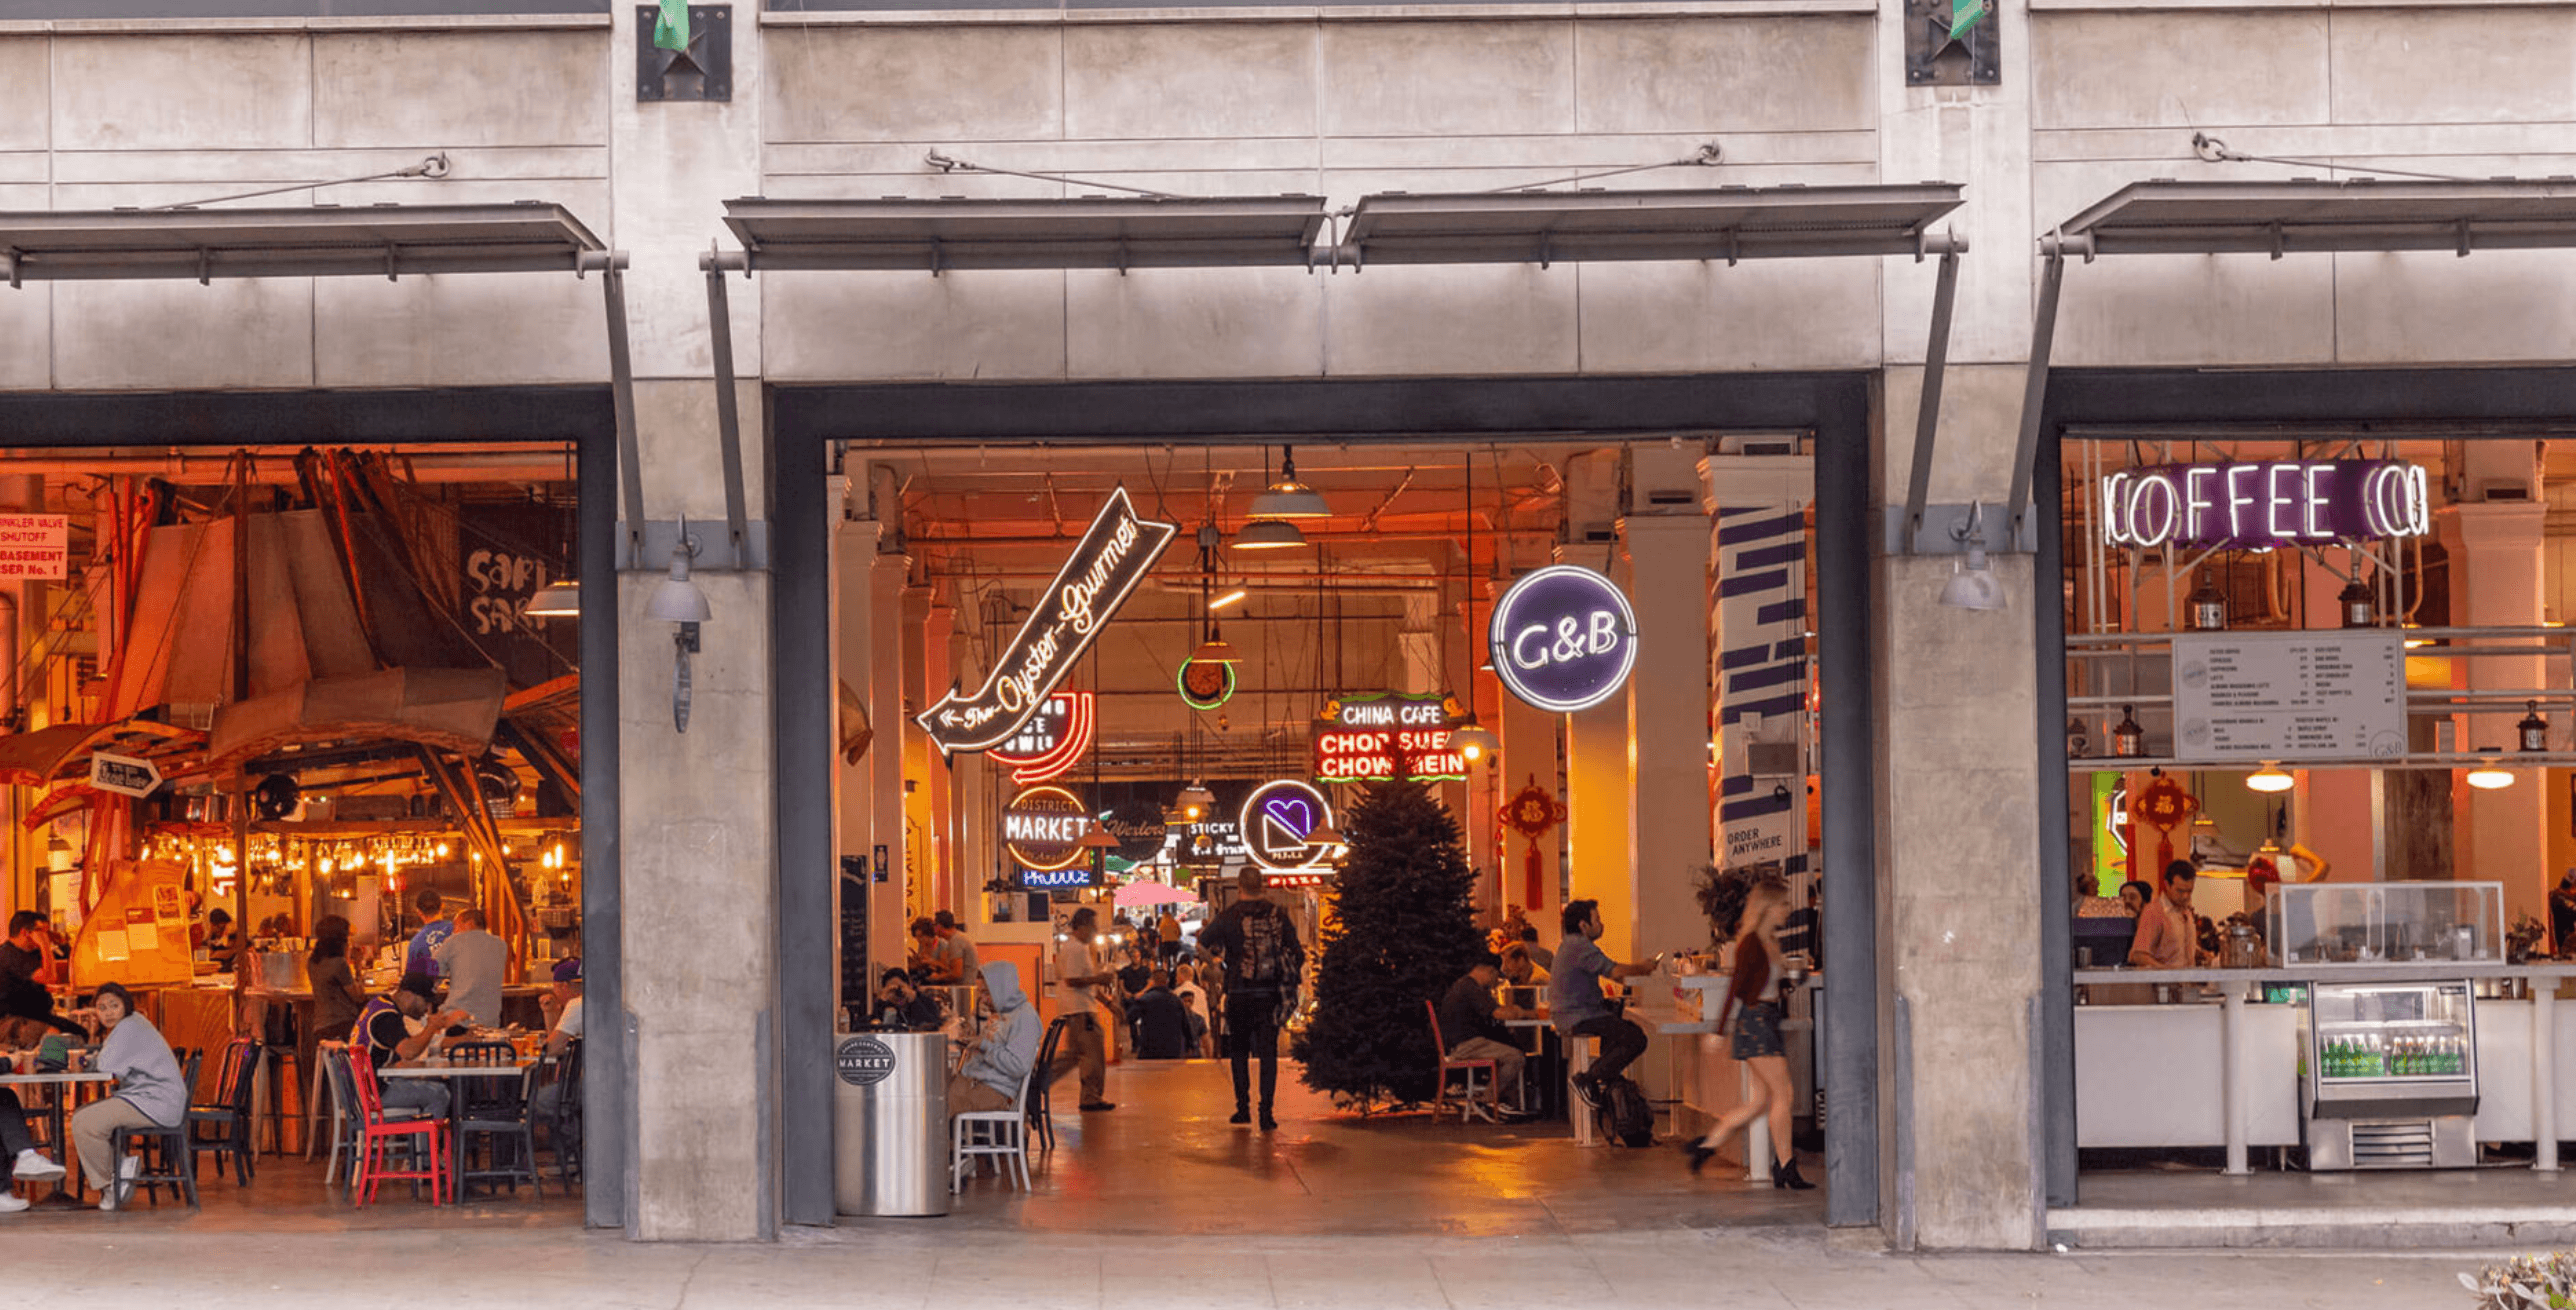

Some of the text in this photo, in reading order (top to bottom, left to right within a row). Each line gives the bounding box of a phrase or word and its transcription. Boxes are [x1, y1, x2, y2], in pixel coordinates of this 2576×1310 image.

[2109, 465, 2337, 546] COFFEE
[0, 531, 48, 542] SHUTOFF
[0, 550, 63, 562] BASEMENT
[1513, 610, 1618, 669] G&B
[1342, 705, 1441, 725] CHINA CAFE
[1321, 756, 1393, 776] CHOW
[1020, 800, 1074, 812] DISTRICT
[1006, 815, 1089, 841] MARKET
[1189, 822, 1235, 835] STICKY
[1727, 827, 1760, 844] ORDER
[1732, 835, 1782, 855] ANYWHERE
[839, 1058, 890, 1068] MARKET
